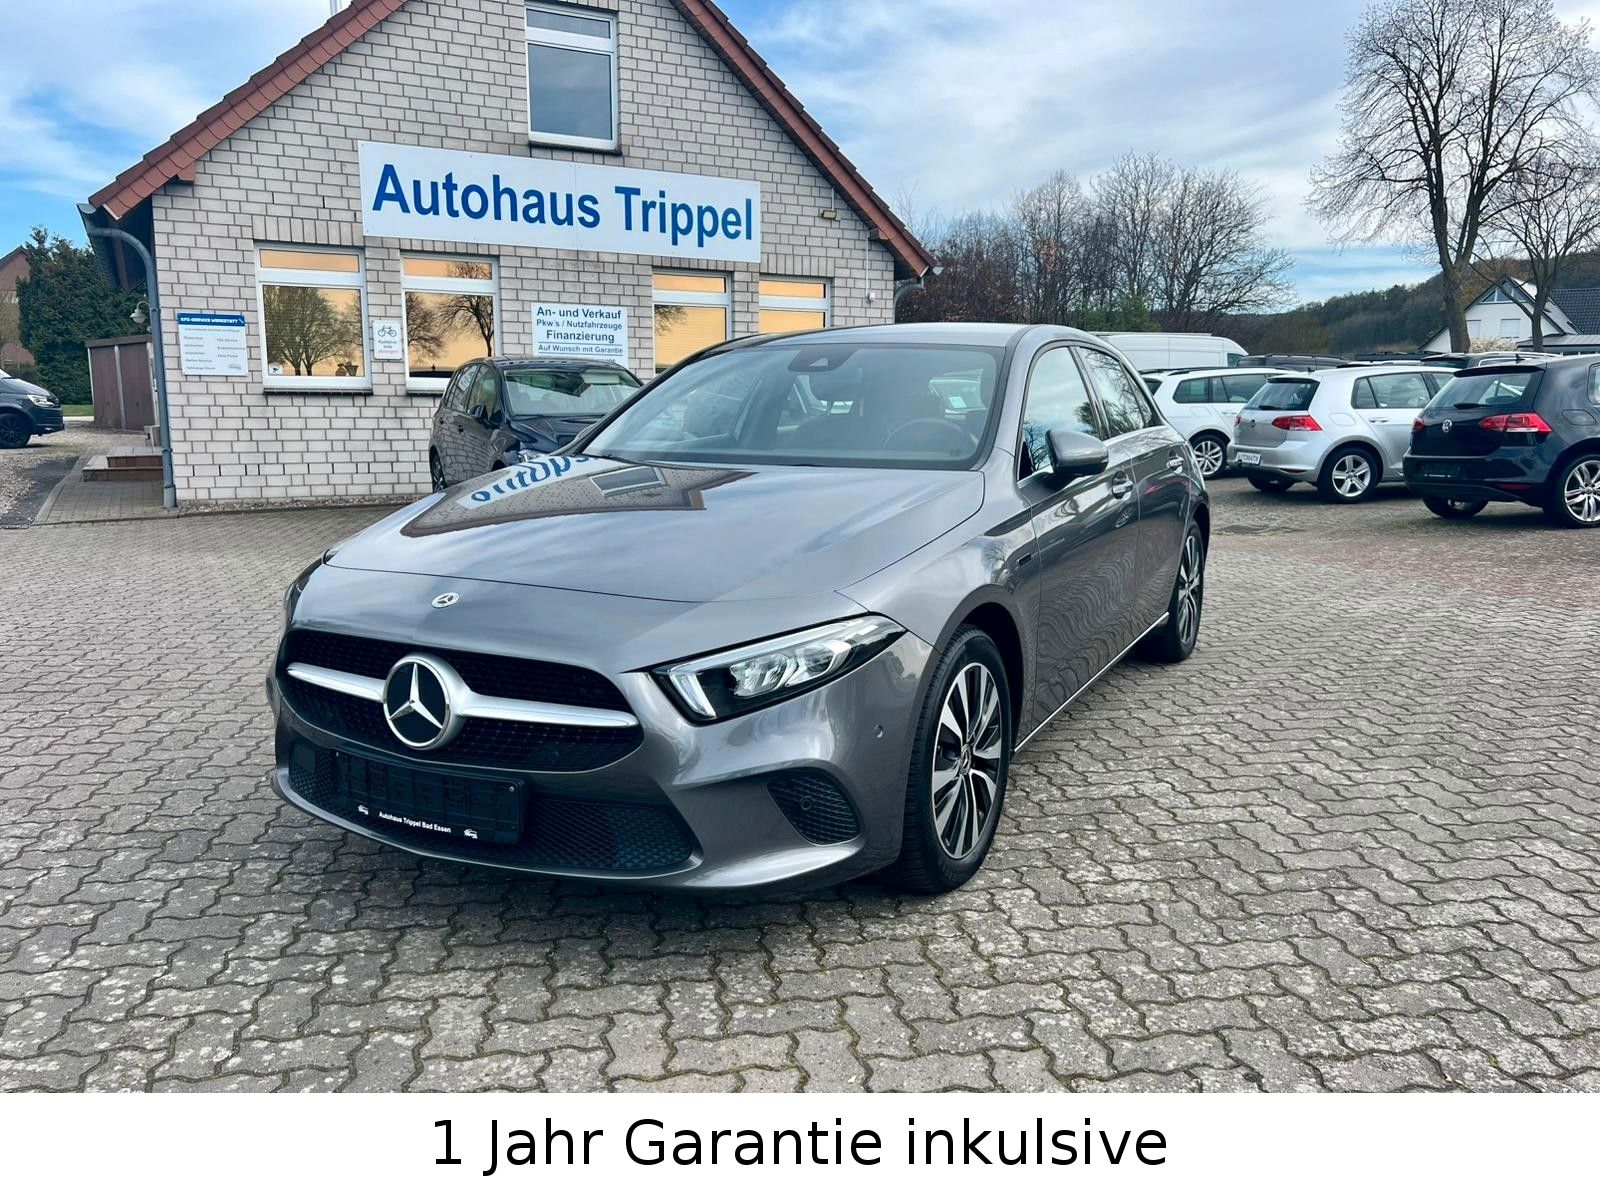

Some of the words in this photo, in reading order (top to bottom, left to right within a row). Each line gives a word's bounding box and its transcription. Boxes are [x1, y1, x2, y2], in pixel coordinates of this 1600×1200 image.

[373, 163, 600, 229] Autohaus
[614, 185, 753, 248] Trippel
[537, 306, 556, 317] An-
[559, 308, 579, 318] und
[582, 308, 622, 319] Verkauf
[567, 320, 623, 331] Nutzfahrzeuge
[546, 330, 615, 344] Finanzierung
[378, 811, 403, 823] Autohaus
[403, 817, 421, 828] Trippel
[421, 820, 434, 830] Bad
[434, 823, 452, 833] Essen
